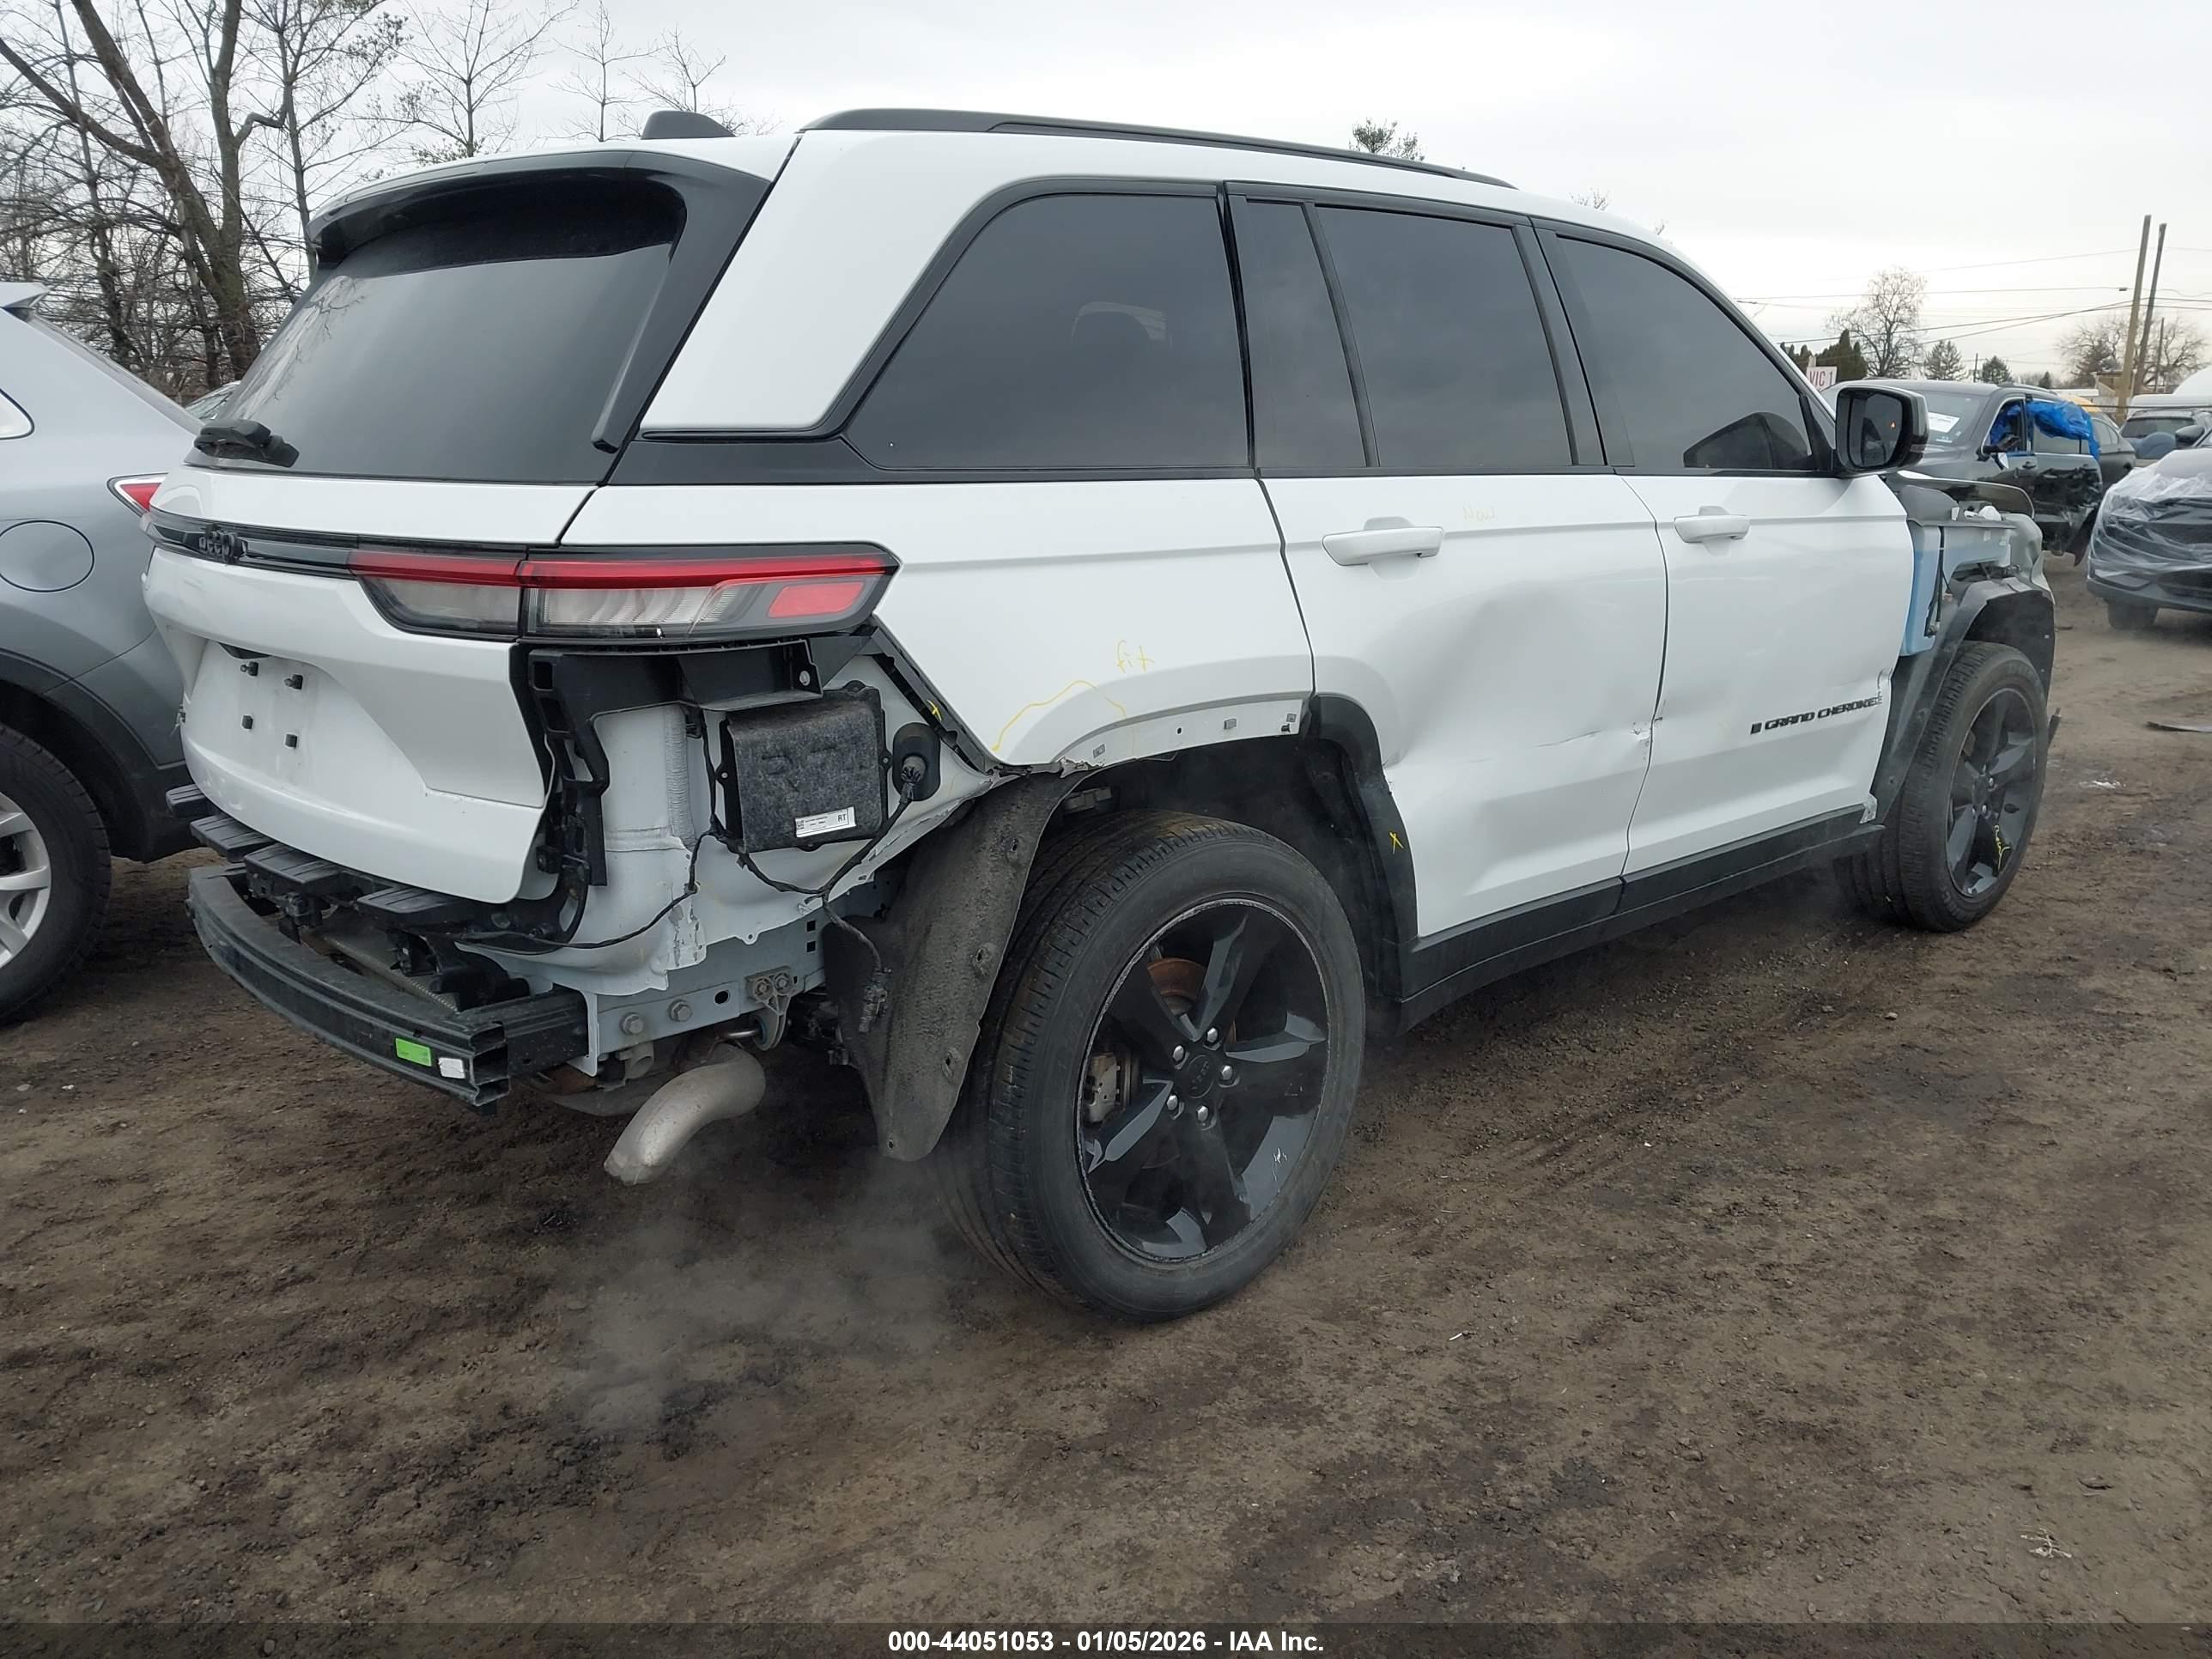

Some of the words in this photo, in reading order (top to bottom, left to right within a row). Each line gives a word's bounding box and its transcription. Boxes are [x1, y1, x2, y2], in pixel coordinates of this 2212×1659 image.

[1808, 370, 1826, 386] VIC
[1764, 711, 1815, 731] GRAND
[1817, 696, 1883, 719] CHEROKEE
[837, 813, 848, 823] RT
